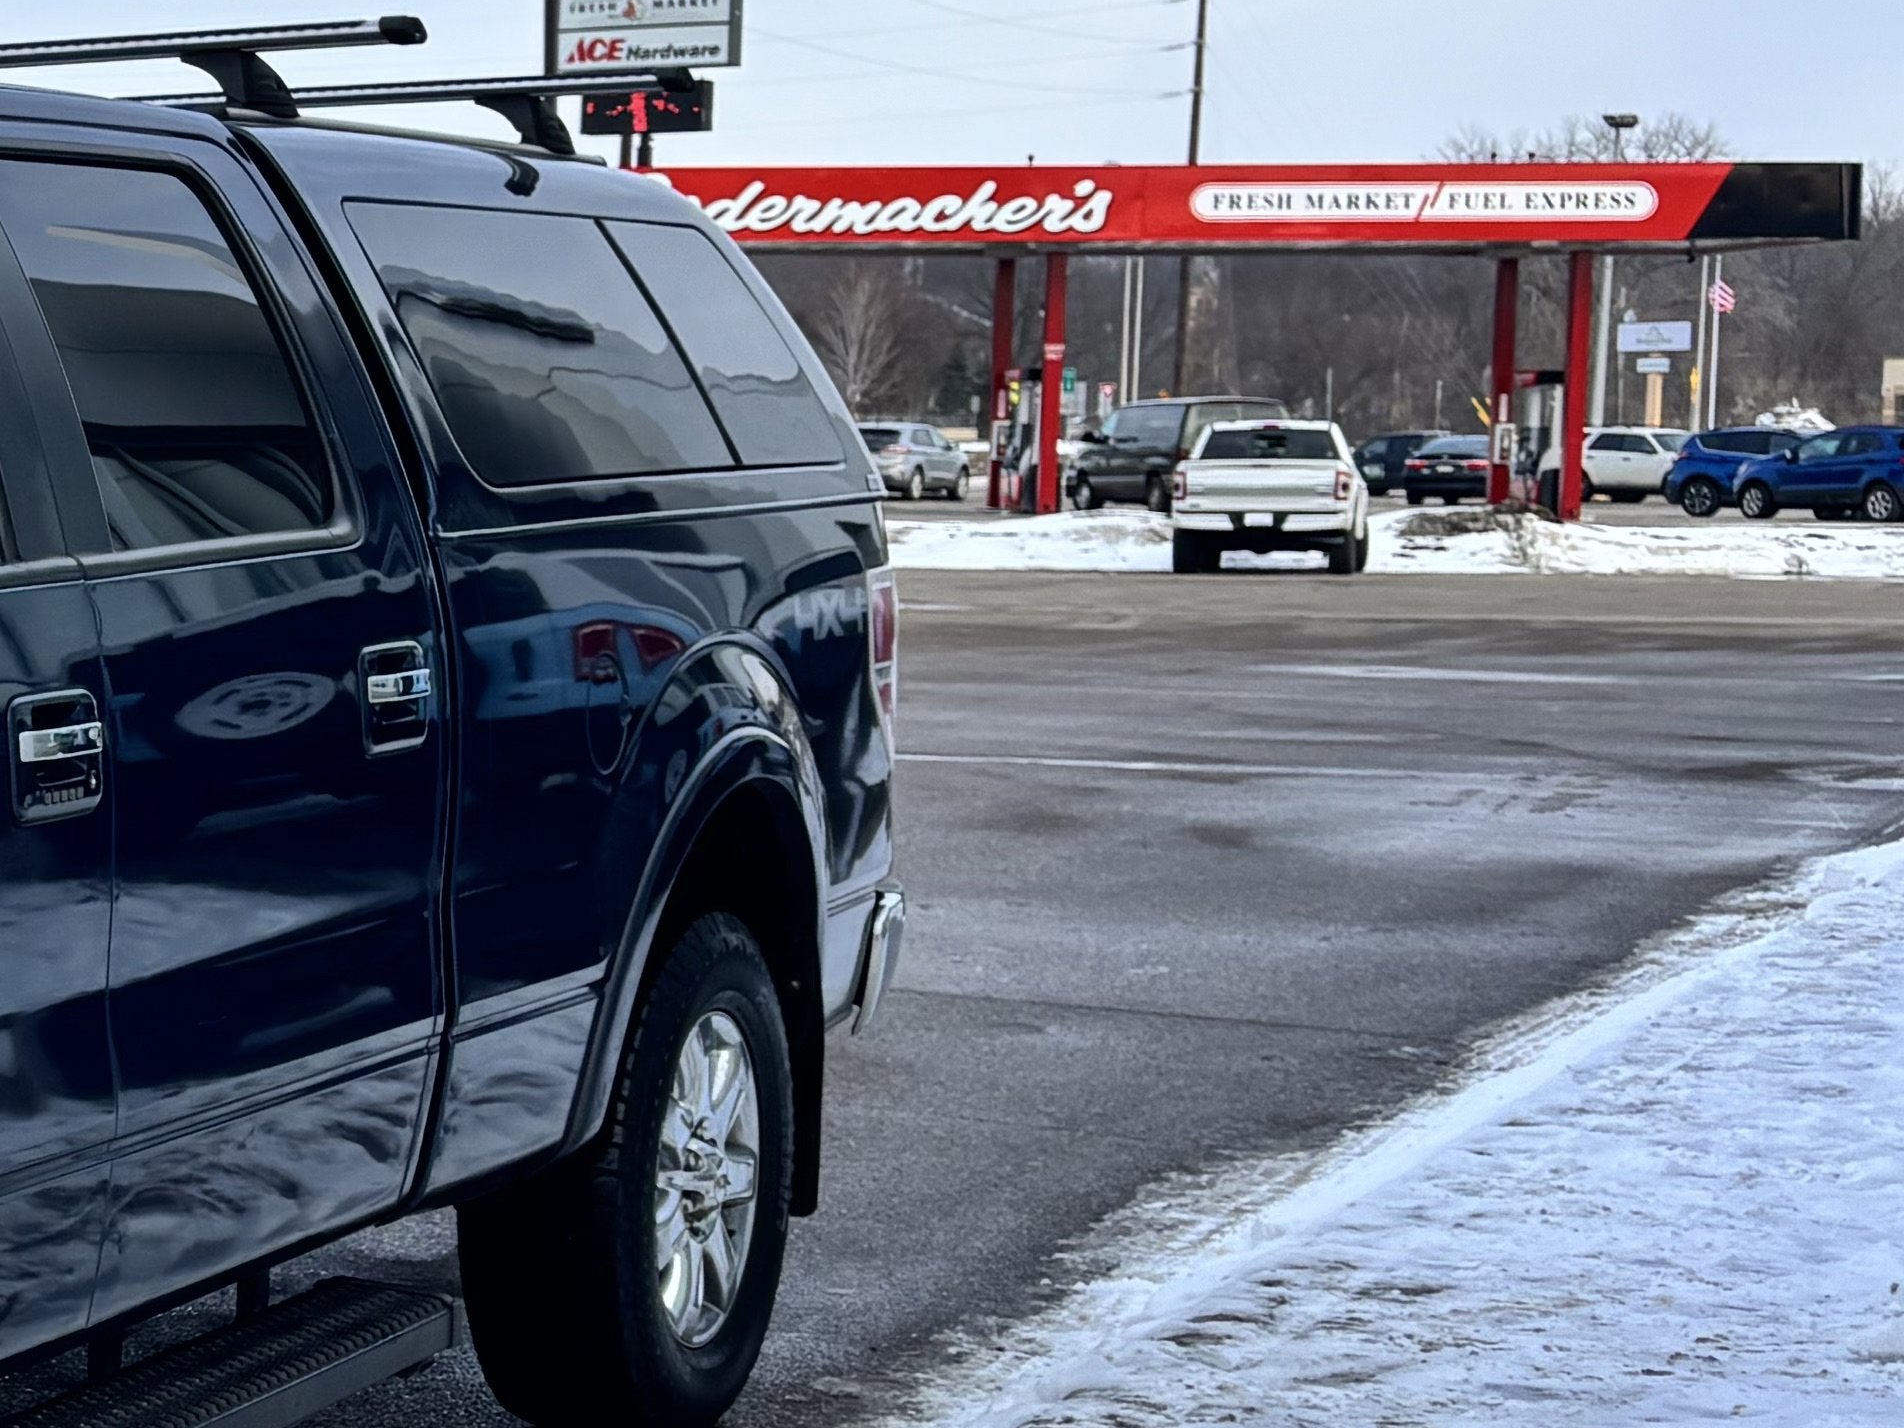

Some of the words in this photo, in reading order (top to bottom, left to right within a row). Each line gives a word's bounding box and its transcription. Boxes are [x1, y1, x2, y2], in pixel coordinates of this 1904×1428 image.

[567, 37, 625, 63] ACE
[625, 43, 721, 62] Hardware
[648, 173, 1113, 234] dermacher's
[1212, 193, 1292, 211] FRESH
[1304, 193, 1417, 211] MARKET
[1448, 192, 1514, 210] FUEL
[1525, 192, 1638, 210] EXPRESS
